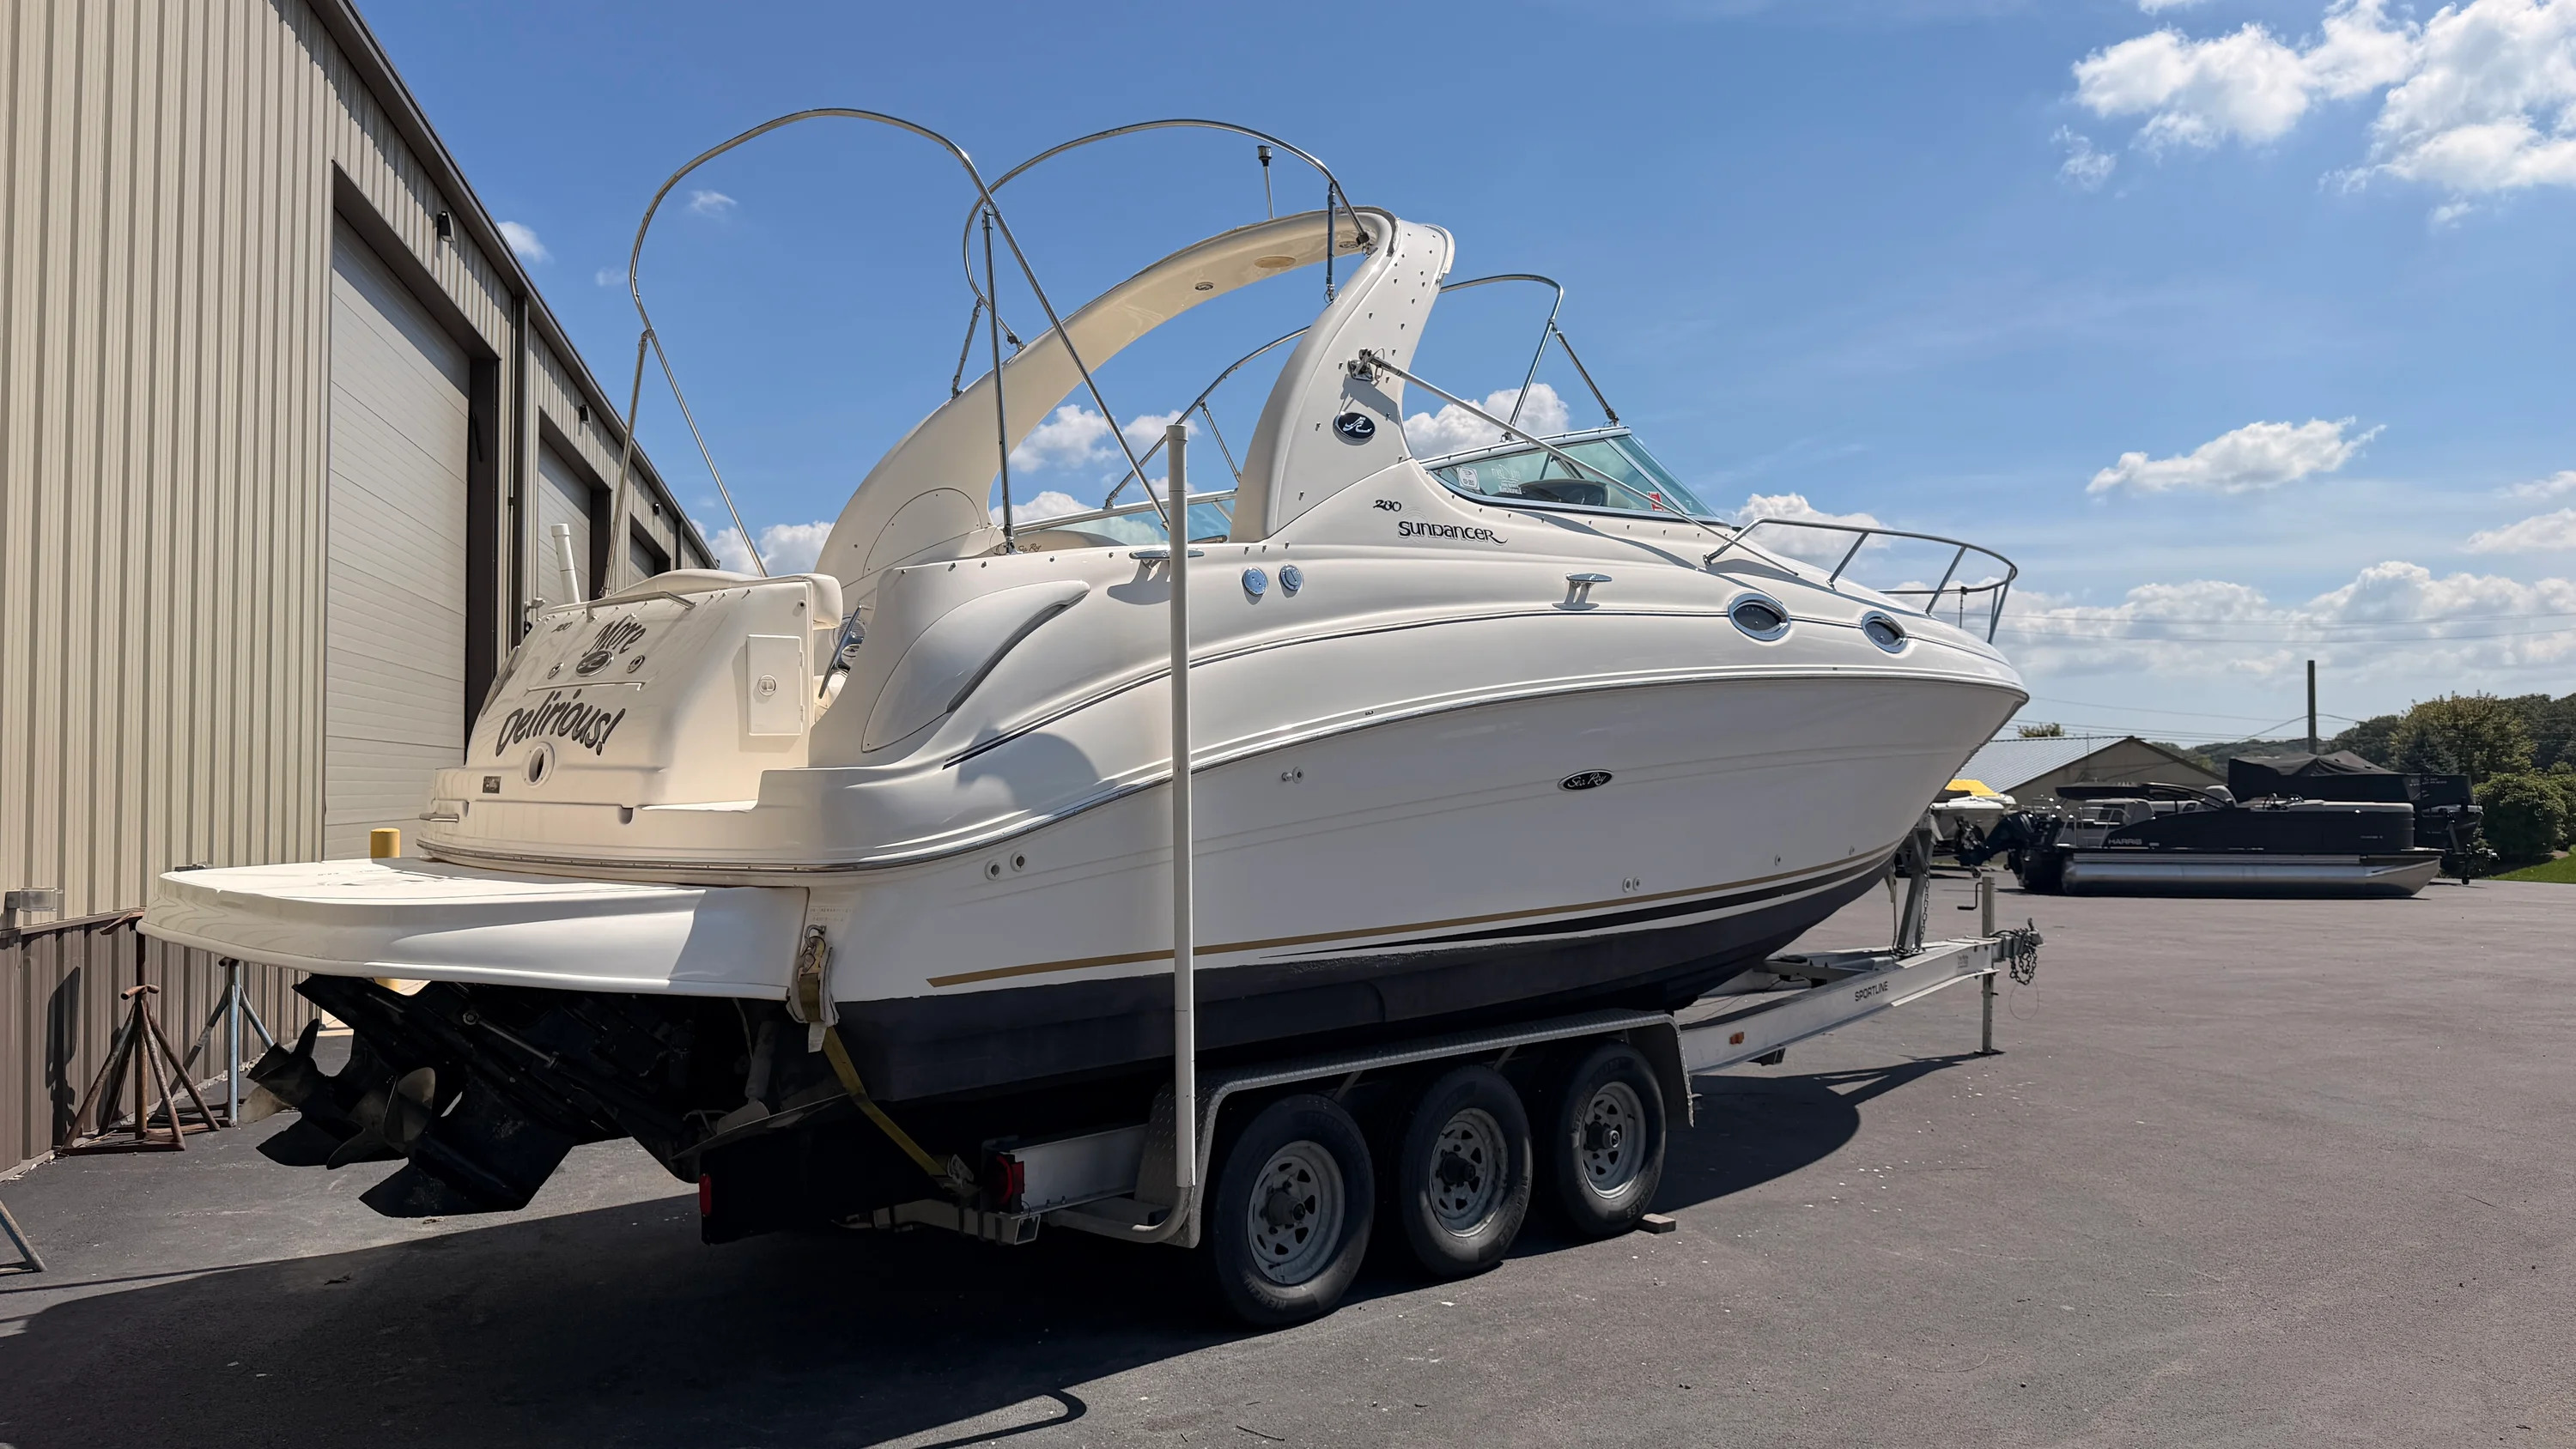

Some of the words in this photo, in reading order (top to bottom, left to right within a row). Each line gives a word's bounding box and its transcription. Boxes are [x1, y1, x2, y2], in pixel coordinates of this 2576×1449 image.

[1373, 499, 1402, 512] 280
[581, 614, 647, 658] More
[495, 688, 626, 757] Delirious!
[1567, 776, 1586, 788] Sea
[1587, 772, 1607, 786] Ray
[1855, 980, 1888, 1002] SPORTLINE
